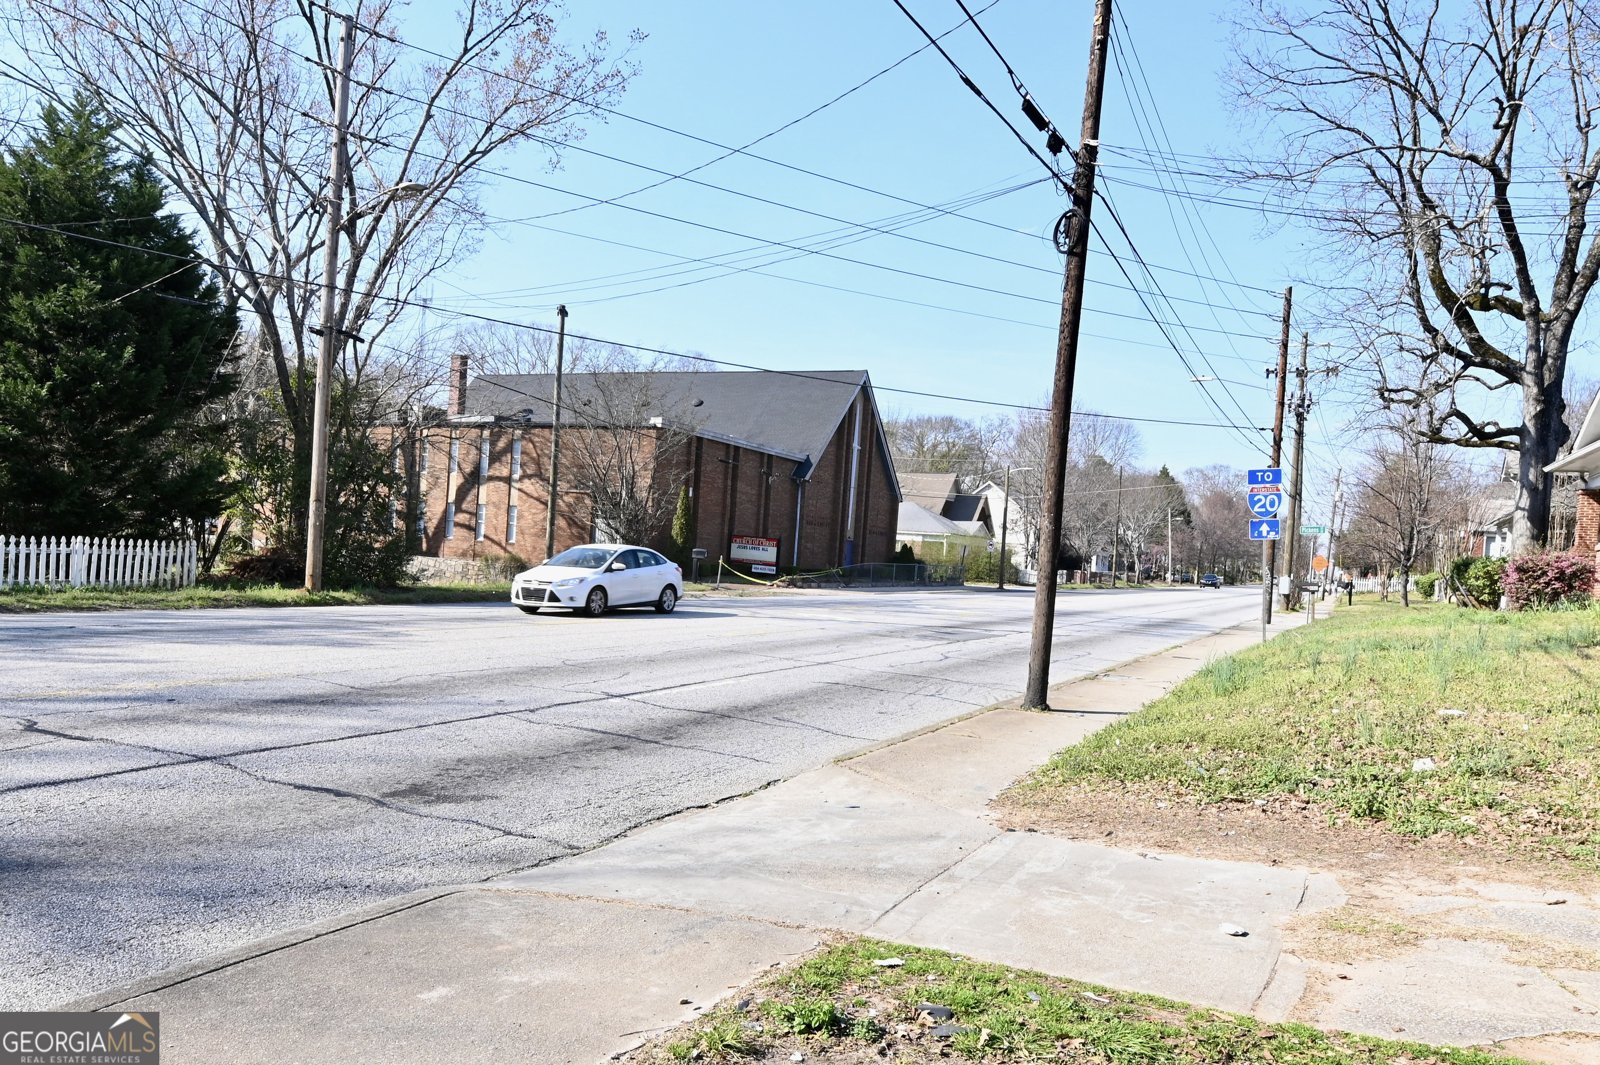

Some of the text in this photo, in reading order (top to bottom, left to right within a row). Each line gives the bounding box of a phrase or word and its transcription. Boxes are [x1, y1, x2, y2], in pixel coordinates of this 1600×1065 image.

[1256, 472, 1273, 482] TO
[1253, 494, 1279, 512] 20
[732, 537, 752, 545] CHURCH
